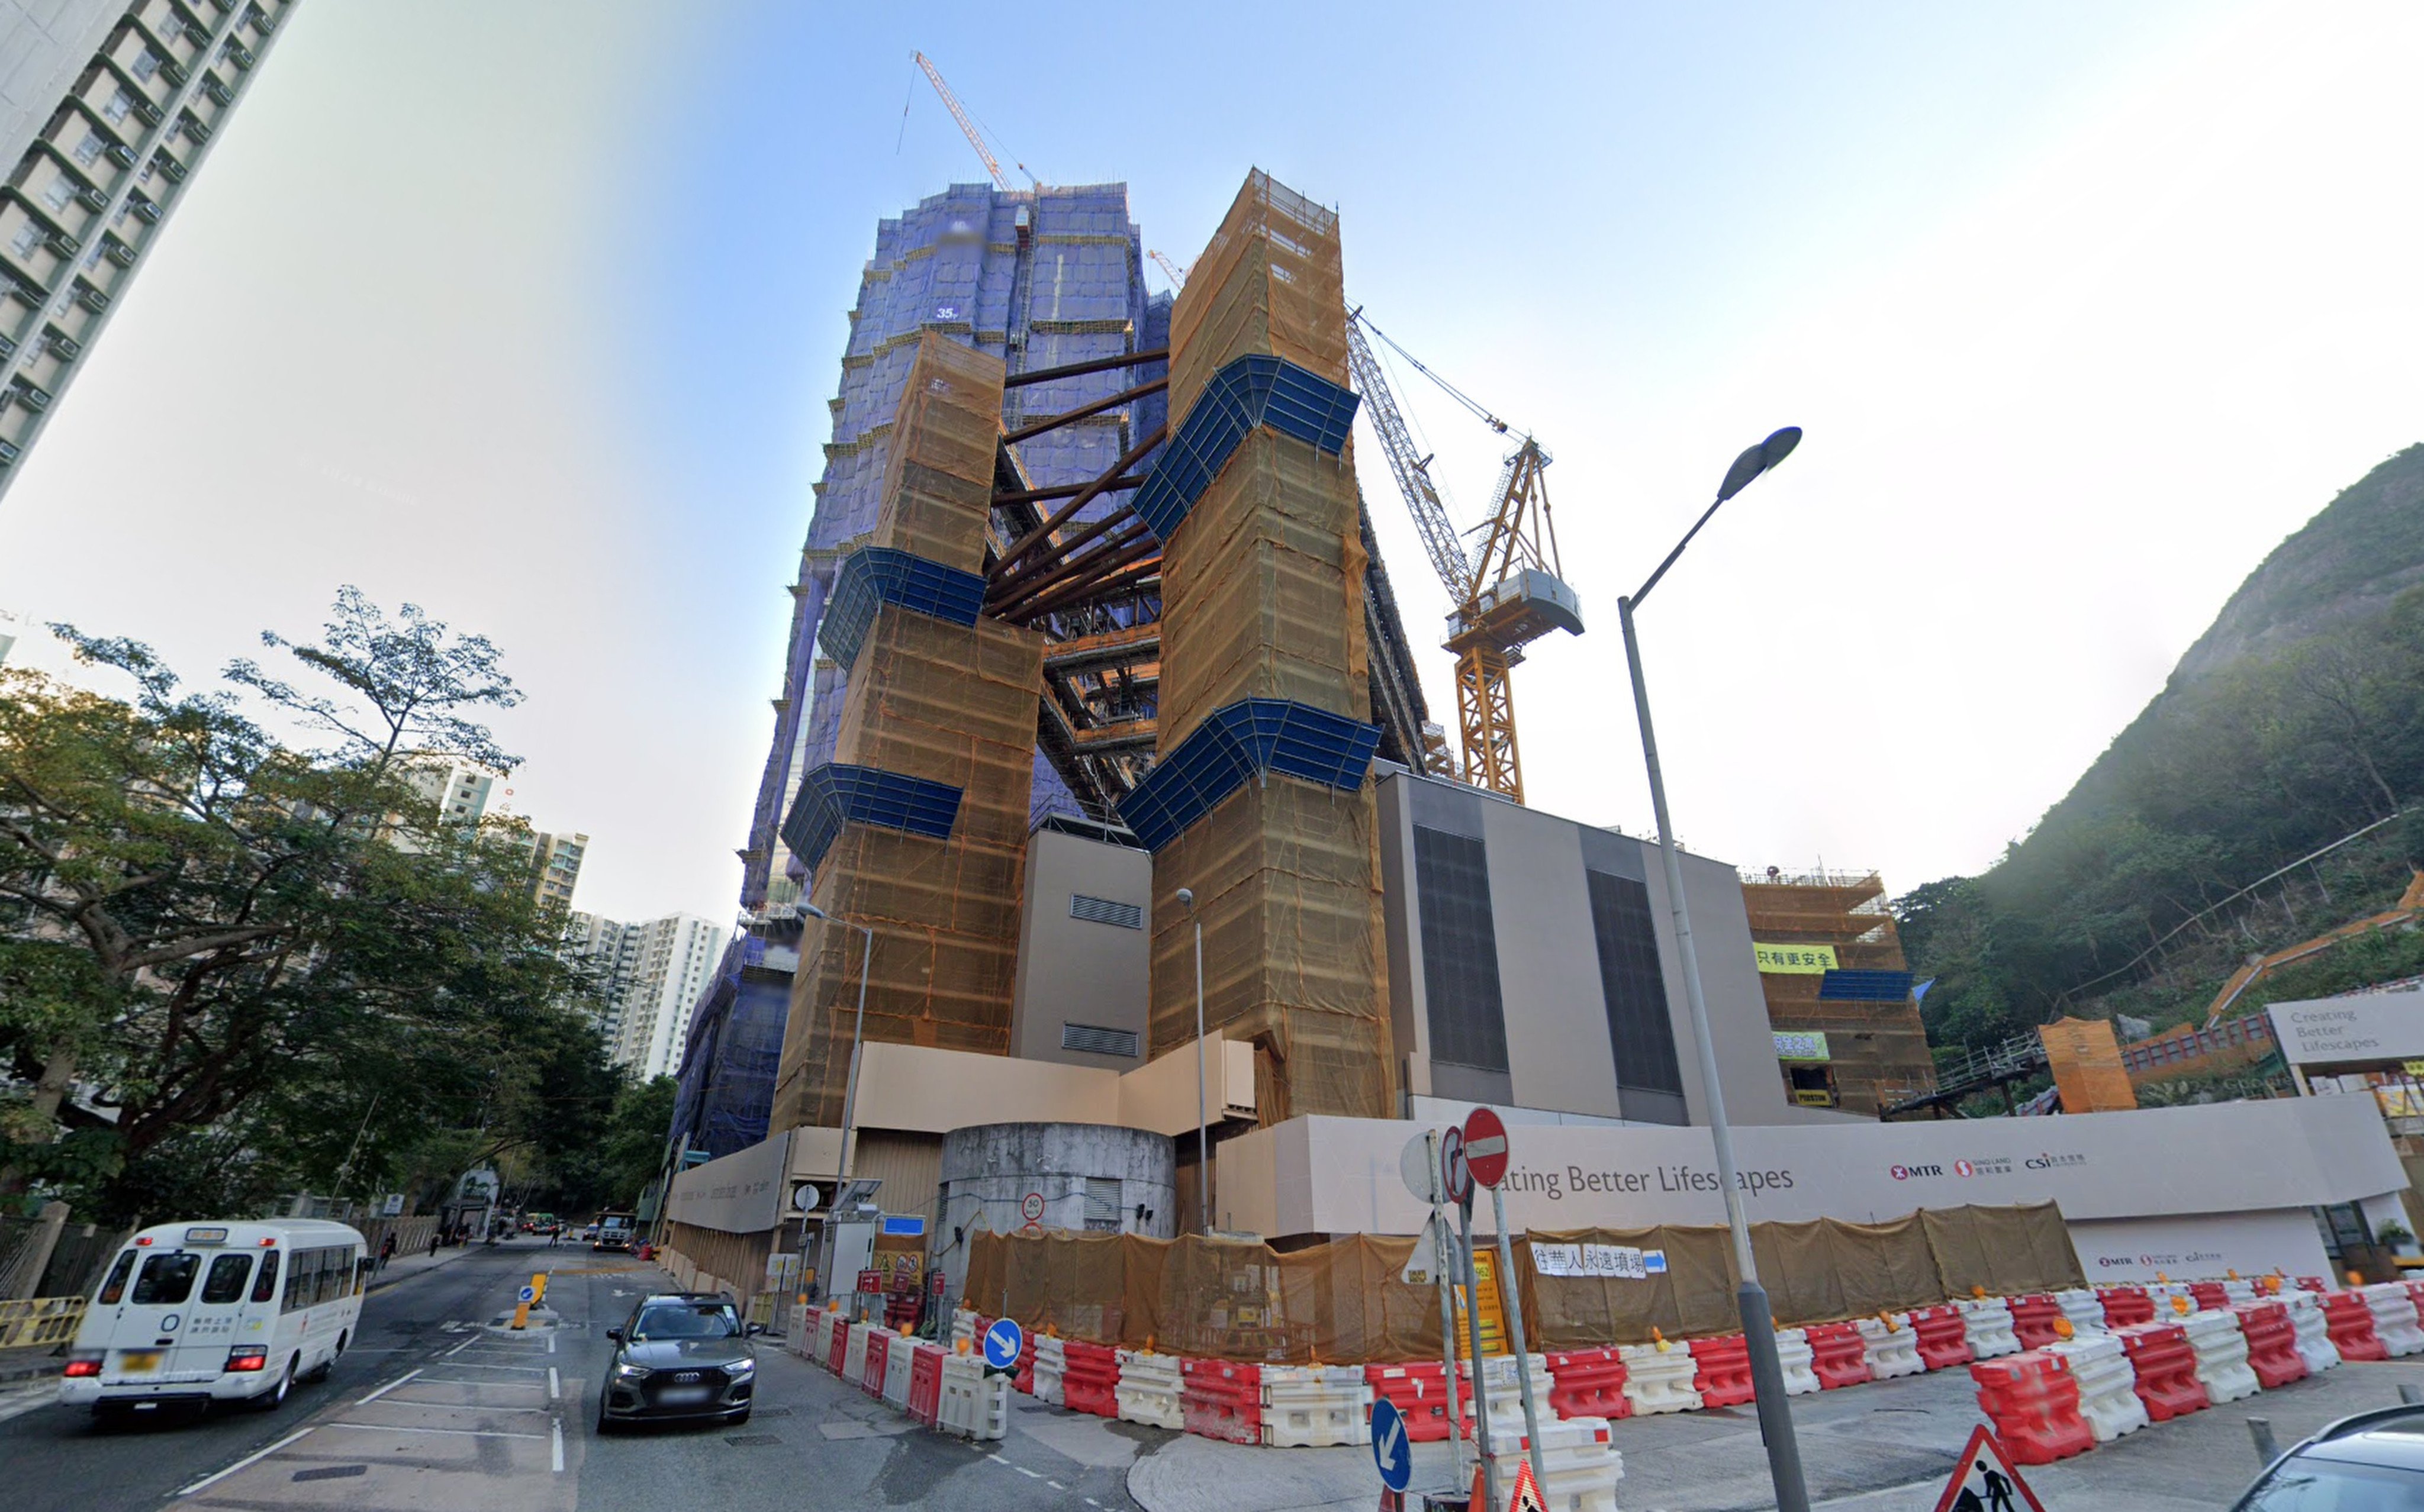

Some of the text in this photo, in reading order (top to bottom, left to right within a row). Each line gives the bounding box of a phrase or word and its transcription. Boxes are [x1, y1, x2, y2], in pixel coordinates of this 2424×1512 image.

[1757, 951, 1832, 966] 只有更安全
[2291, 1010, 2357, 1023] Creating
[2296, 1025, 2344, 1038] Better
[2301, 1039, 2380, 1052] Lifescapes
[1908, 1165, 1943, 1178] MTR
[1501, 1165, 1794, 1200] ating Better Lifesapes
[1534, 1249, 1644, 1273] 往華人永遠墳場
